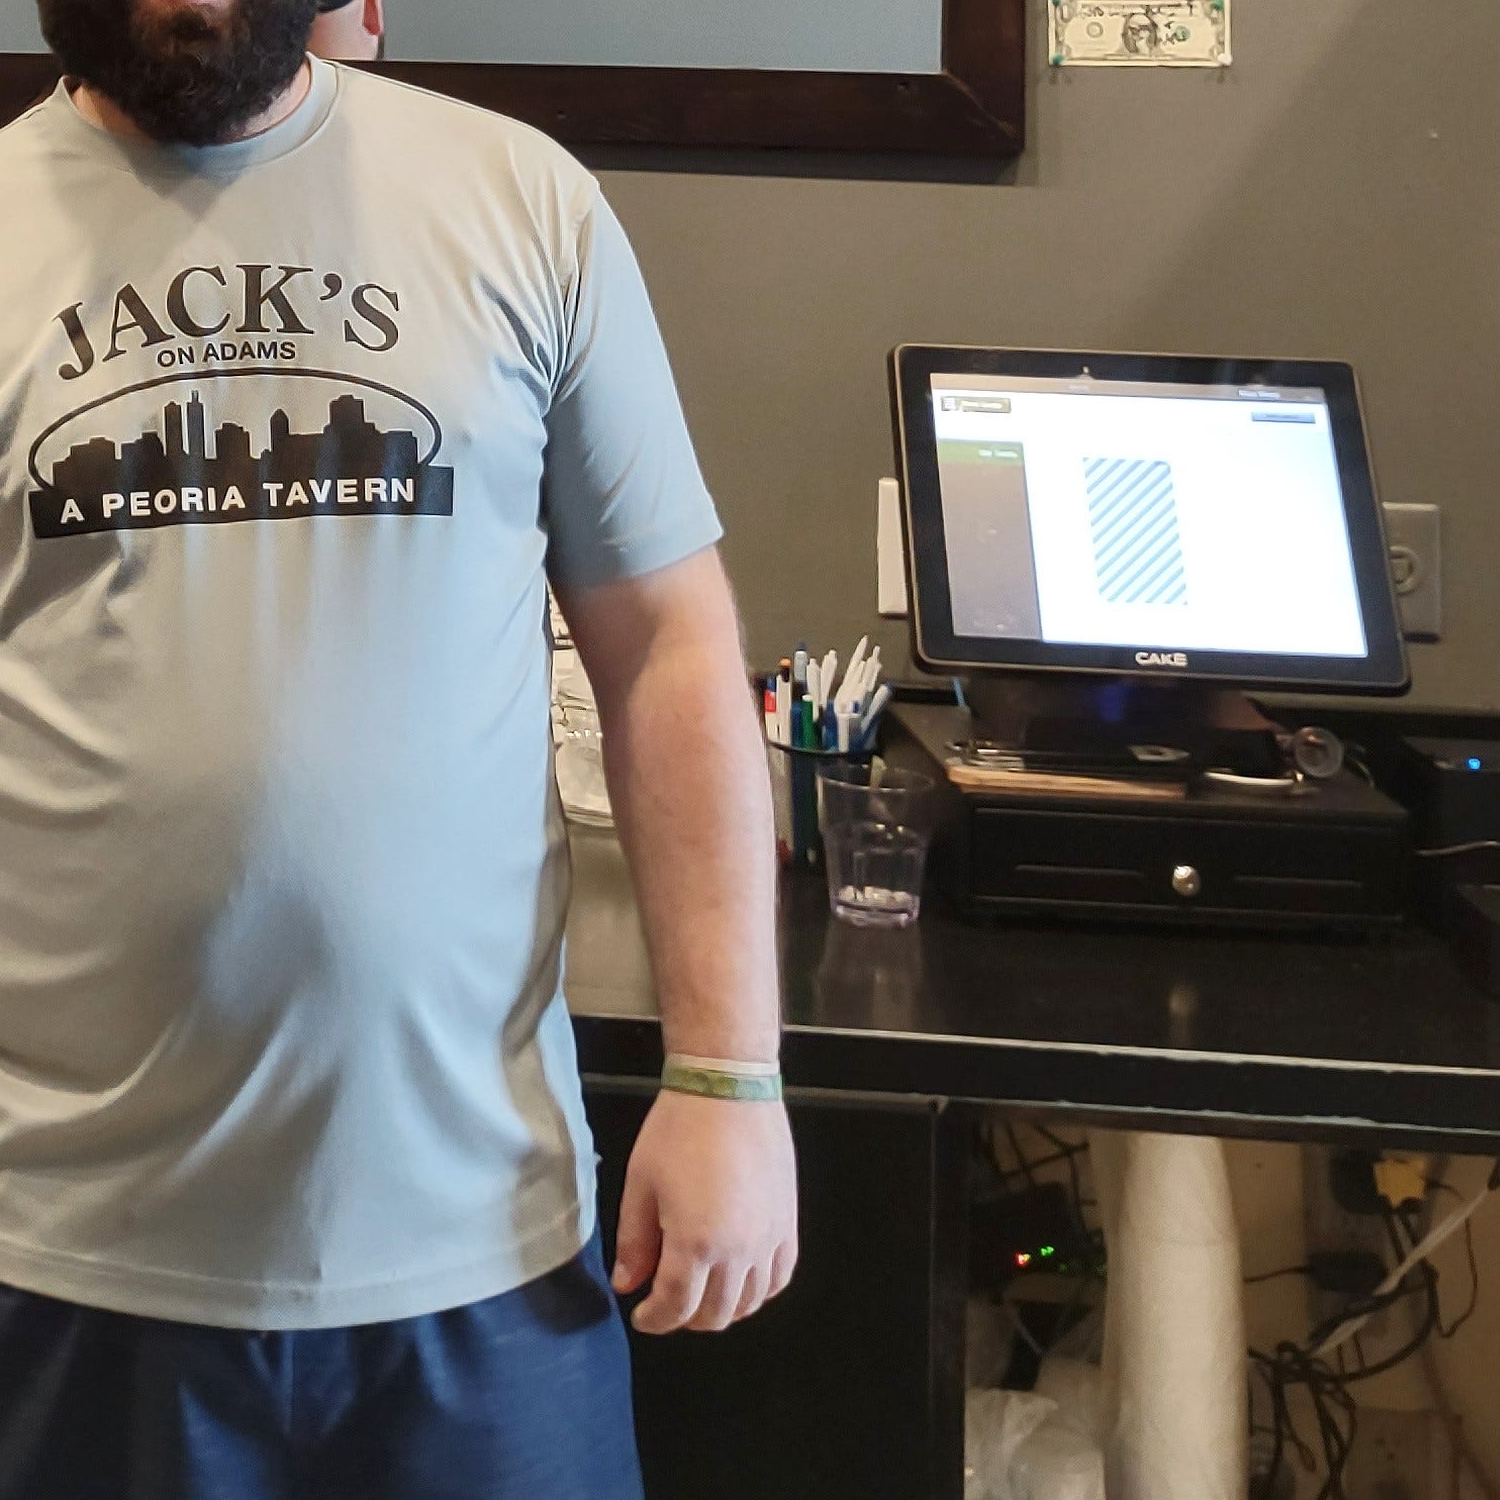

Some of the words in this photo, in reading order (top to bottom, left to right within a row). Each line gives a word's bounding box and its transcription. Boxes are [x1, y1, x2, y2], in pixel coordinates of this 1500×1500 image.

[52, 264, 400, 381] JACK'S
[157, 346, 195, 368] ON
[202, 341, 296, 363] ADAMS
[60, 498, 85, 524] A
[102, 486, 246, 518] PEORIA
[262, 477, 415, 506] TAVERN
[1135, 651, 1187, 667] CAKE
